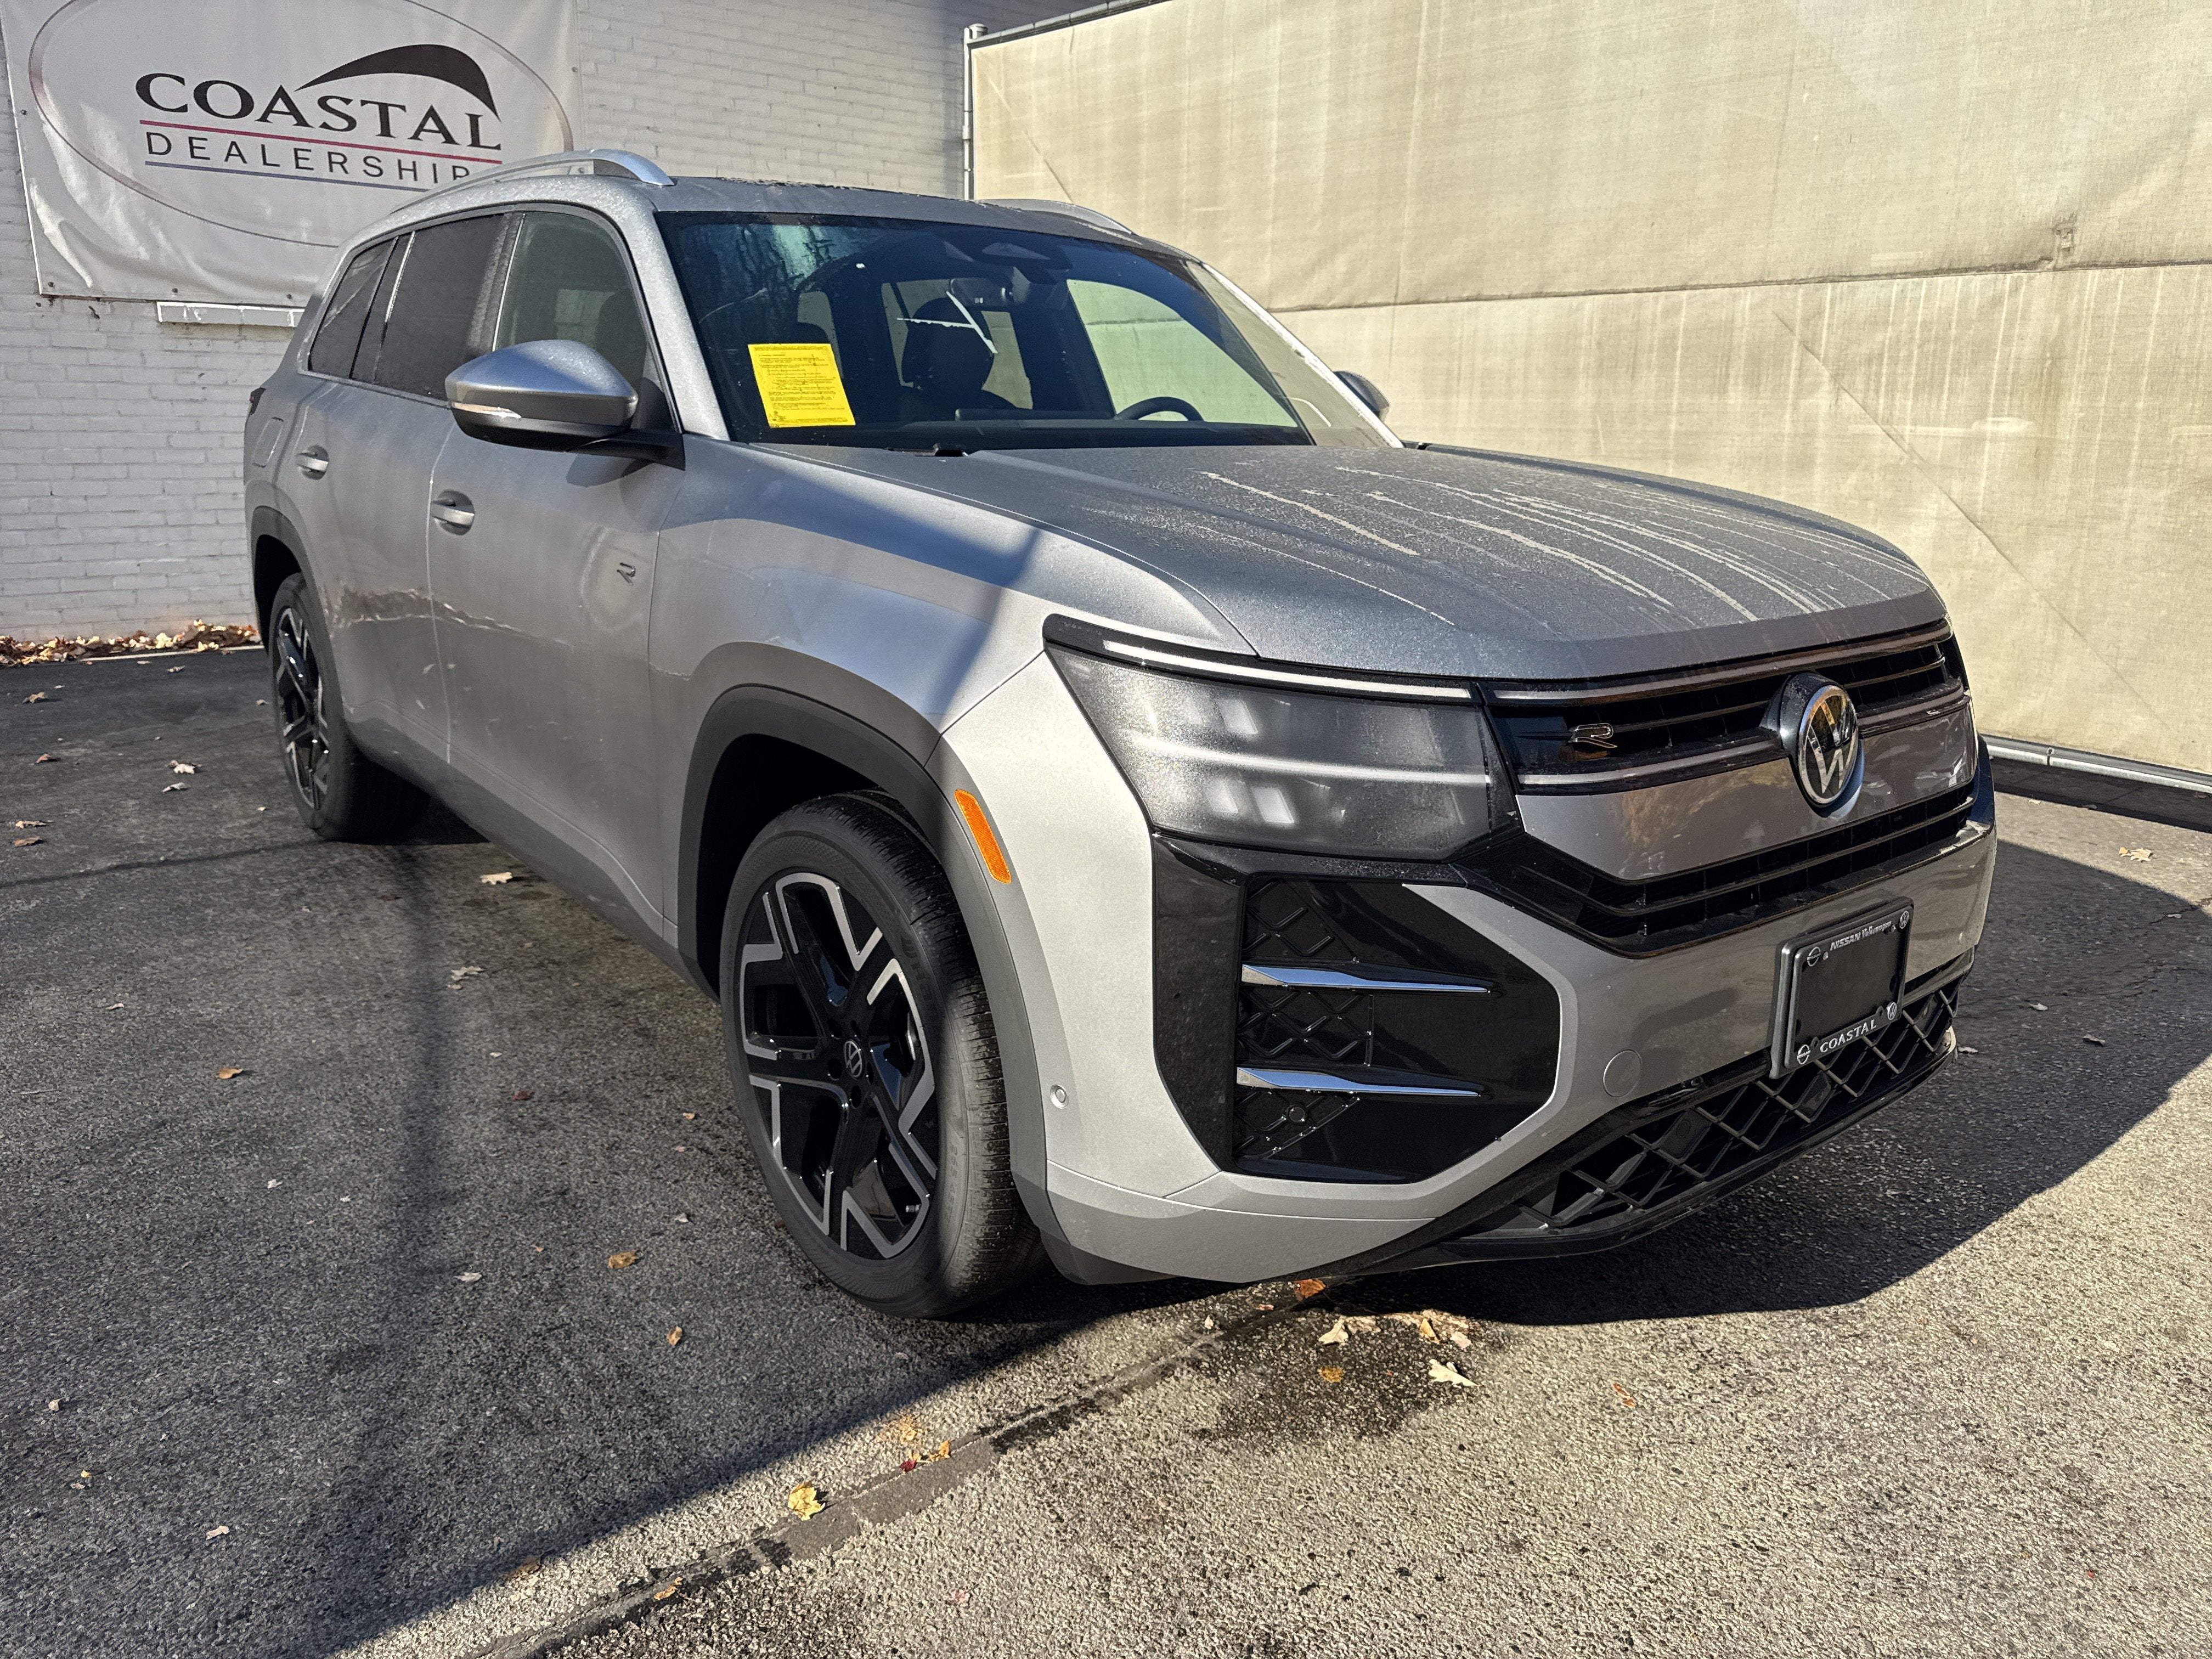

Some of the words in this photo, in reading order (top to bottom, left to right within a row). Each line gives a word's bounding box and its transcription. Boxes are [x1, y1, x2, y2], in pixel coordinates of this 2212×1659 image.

[136, 73, 501, 150] COASTAL
[1568, 723, 1617, 748] R
[1830, 932, 1860, 951] NISSAN
[1820, 1019, 1877, 1053] COASTAL
